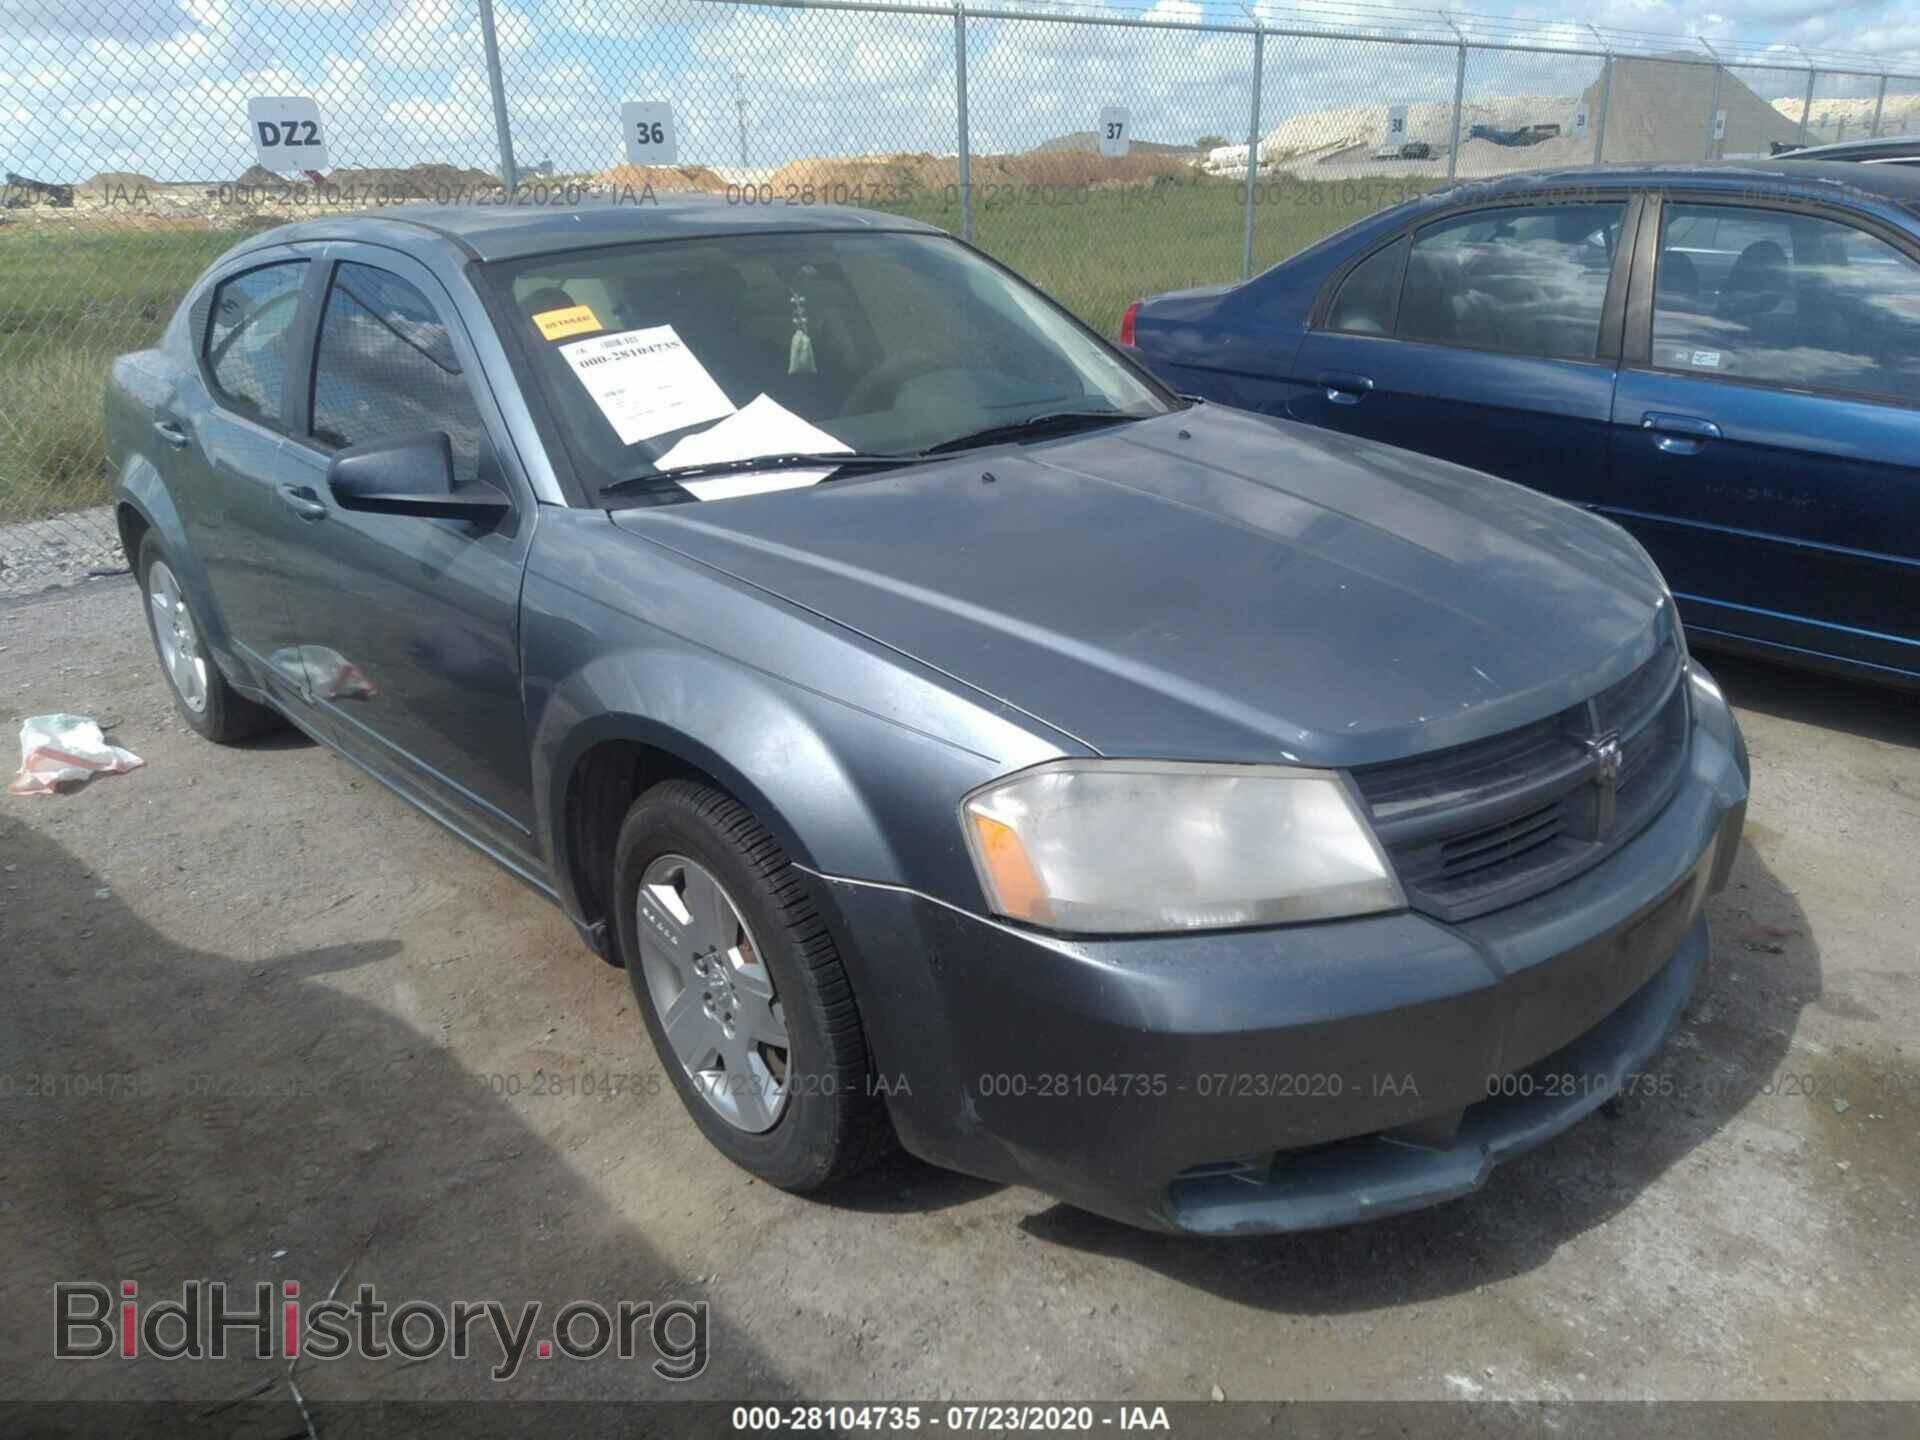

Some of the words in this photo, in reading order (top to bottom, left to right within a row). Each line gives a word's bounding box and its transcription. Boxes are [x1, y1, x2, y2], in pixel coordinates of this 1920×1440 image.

[257, 120, 322, 147] DZ2
[636, 121, 665, 144] 36
[1106, 122, 1123, 140] 37
